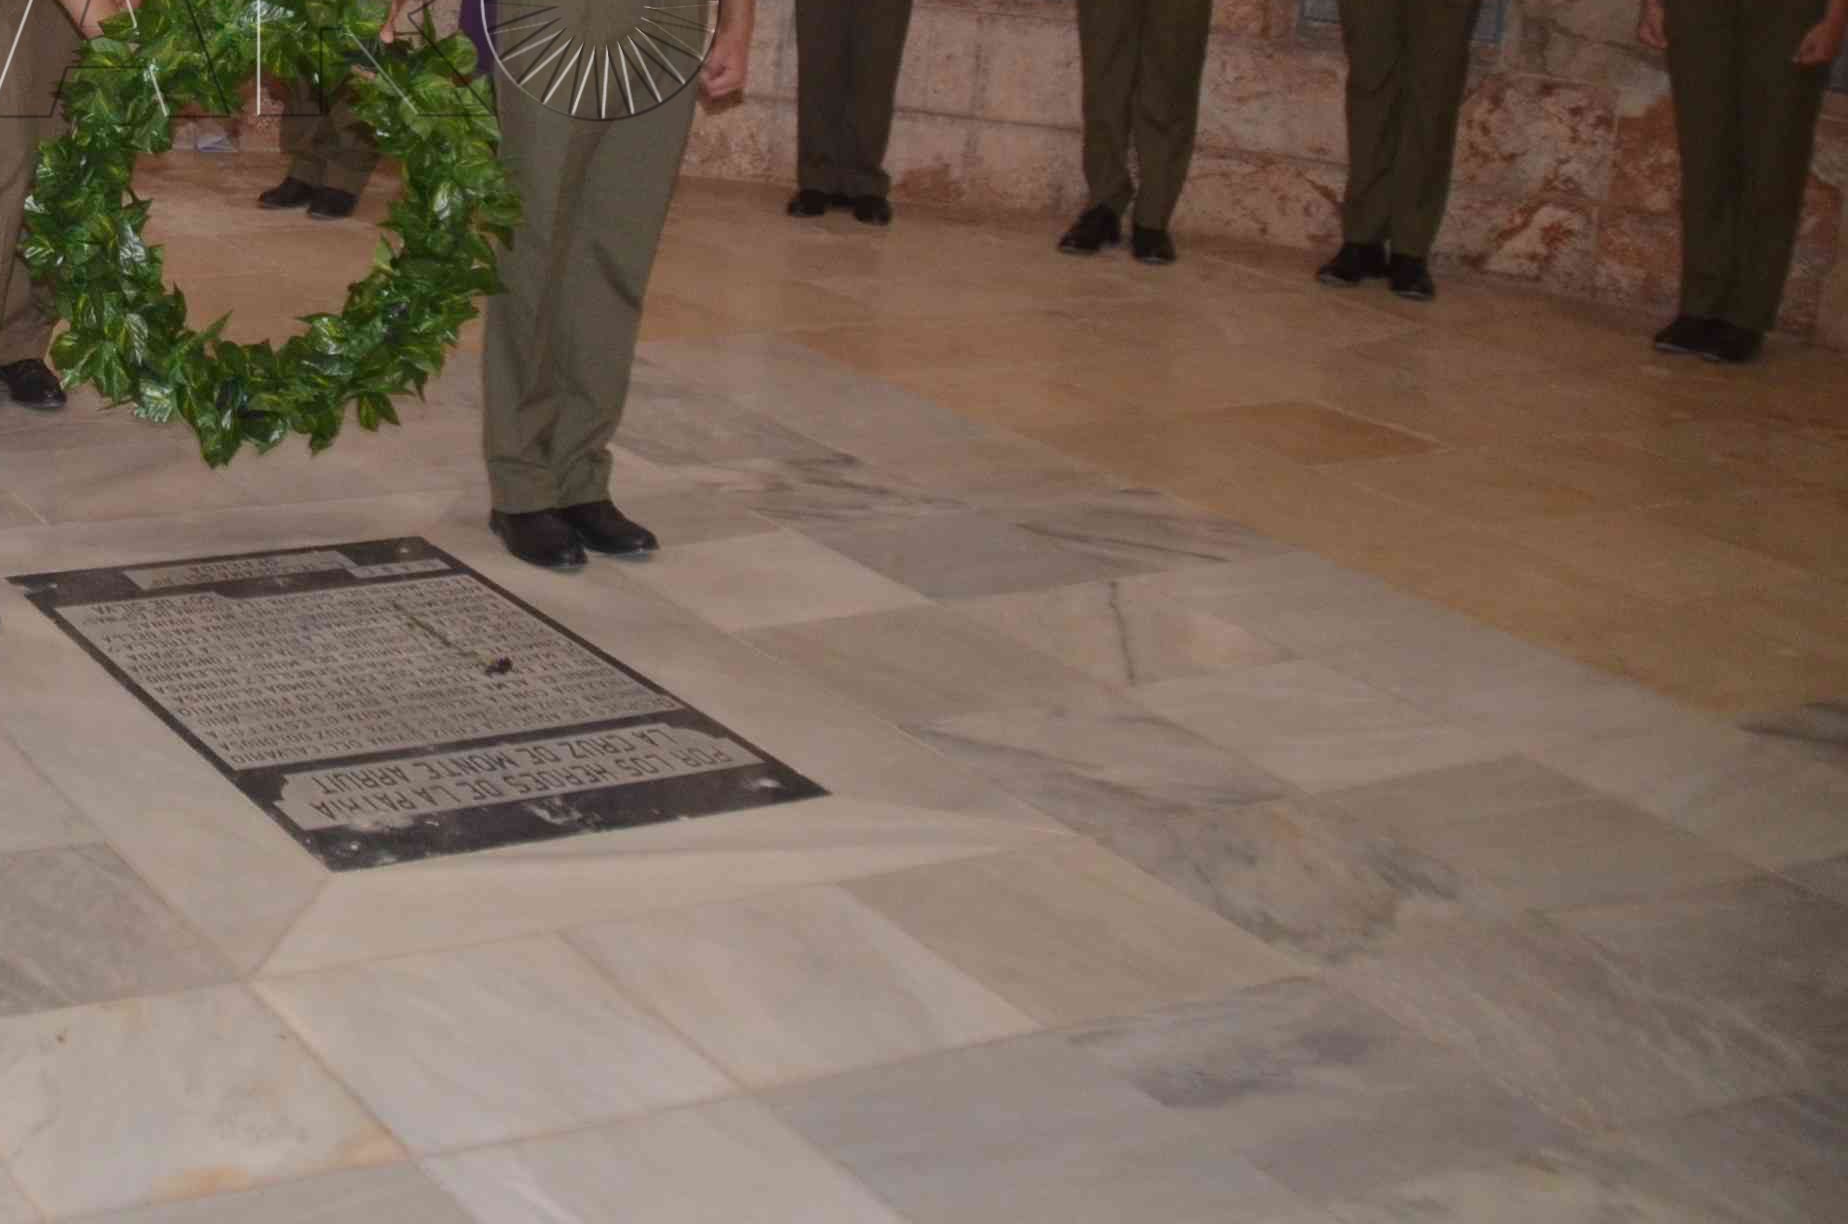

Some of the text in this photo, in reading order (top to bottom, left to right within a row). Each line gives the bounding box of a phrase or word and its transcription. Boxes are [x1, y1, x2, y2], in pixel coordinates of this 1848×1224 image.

[304, 727, 682, 795] LA CRUZ DE MONTE ARRUIT
[307, 744, 738, 822] POR LOS HEROES DE LA PATRIA
